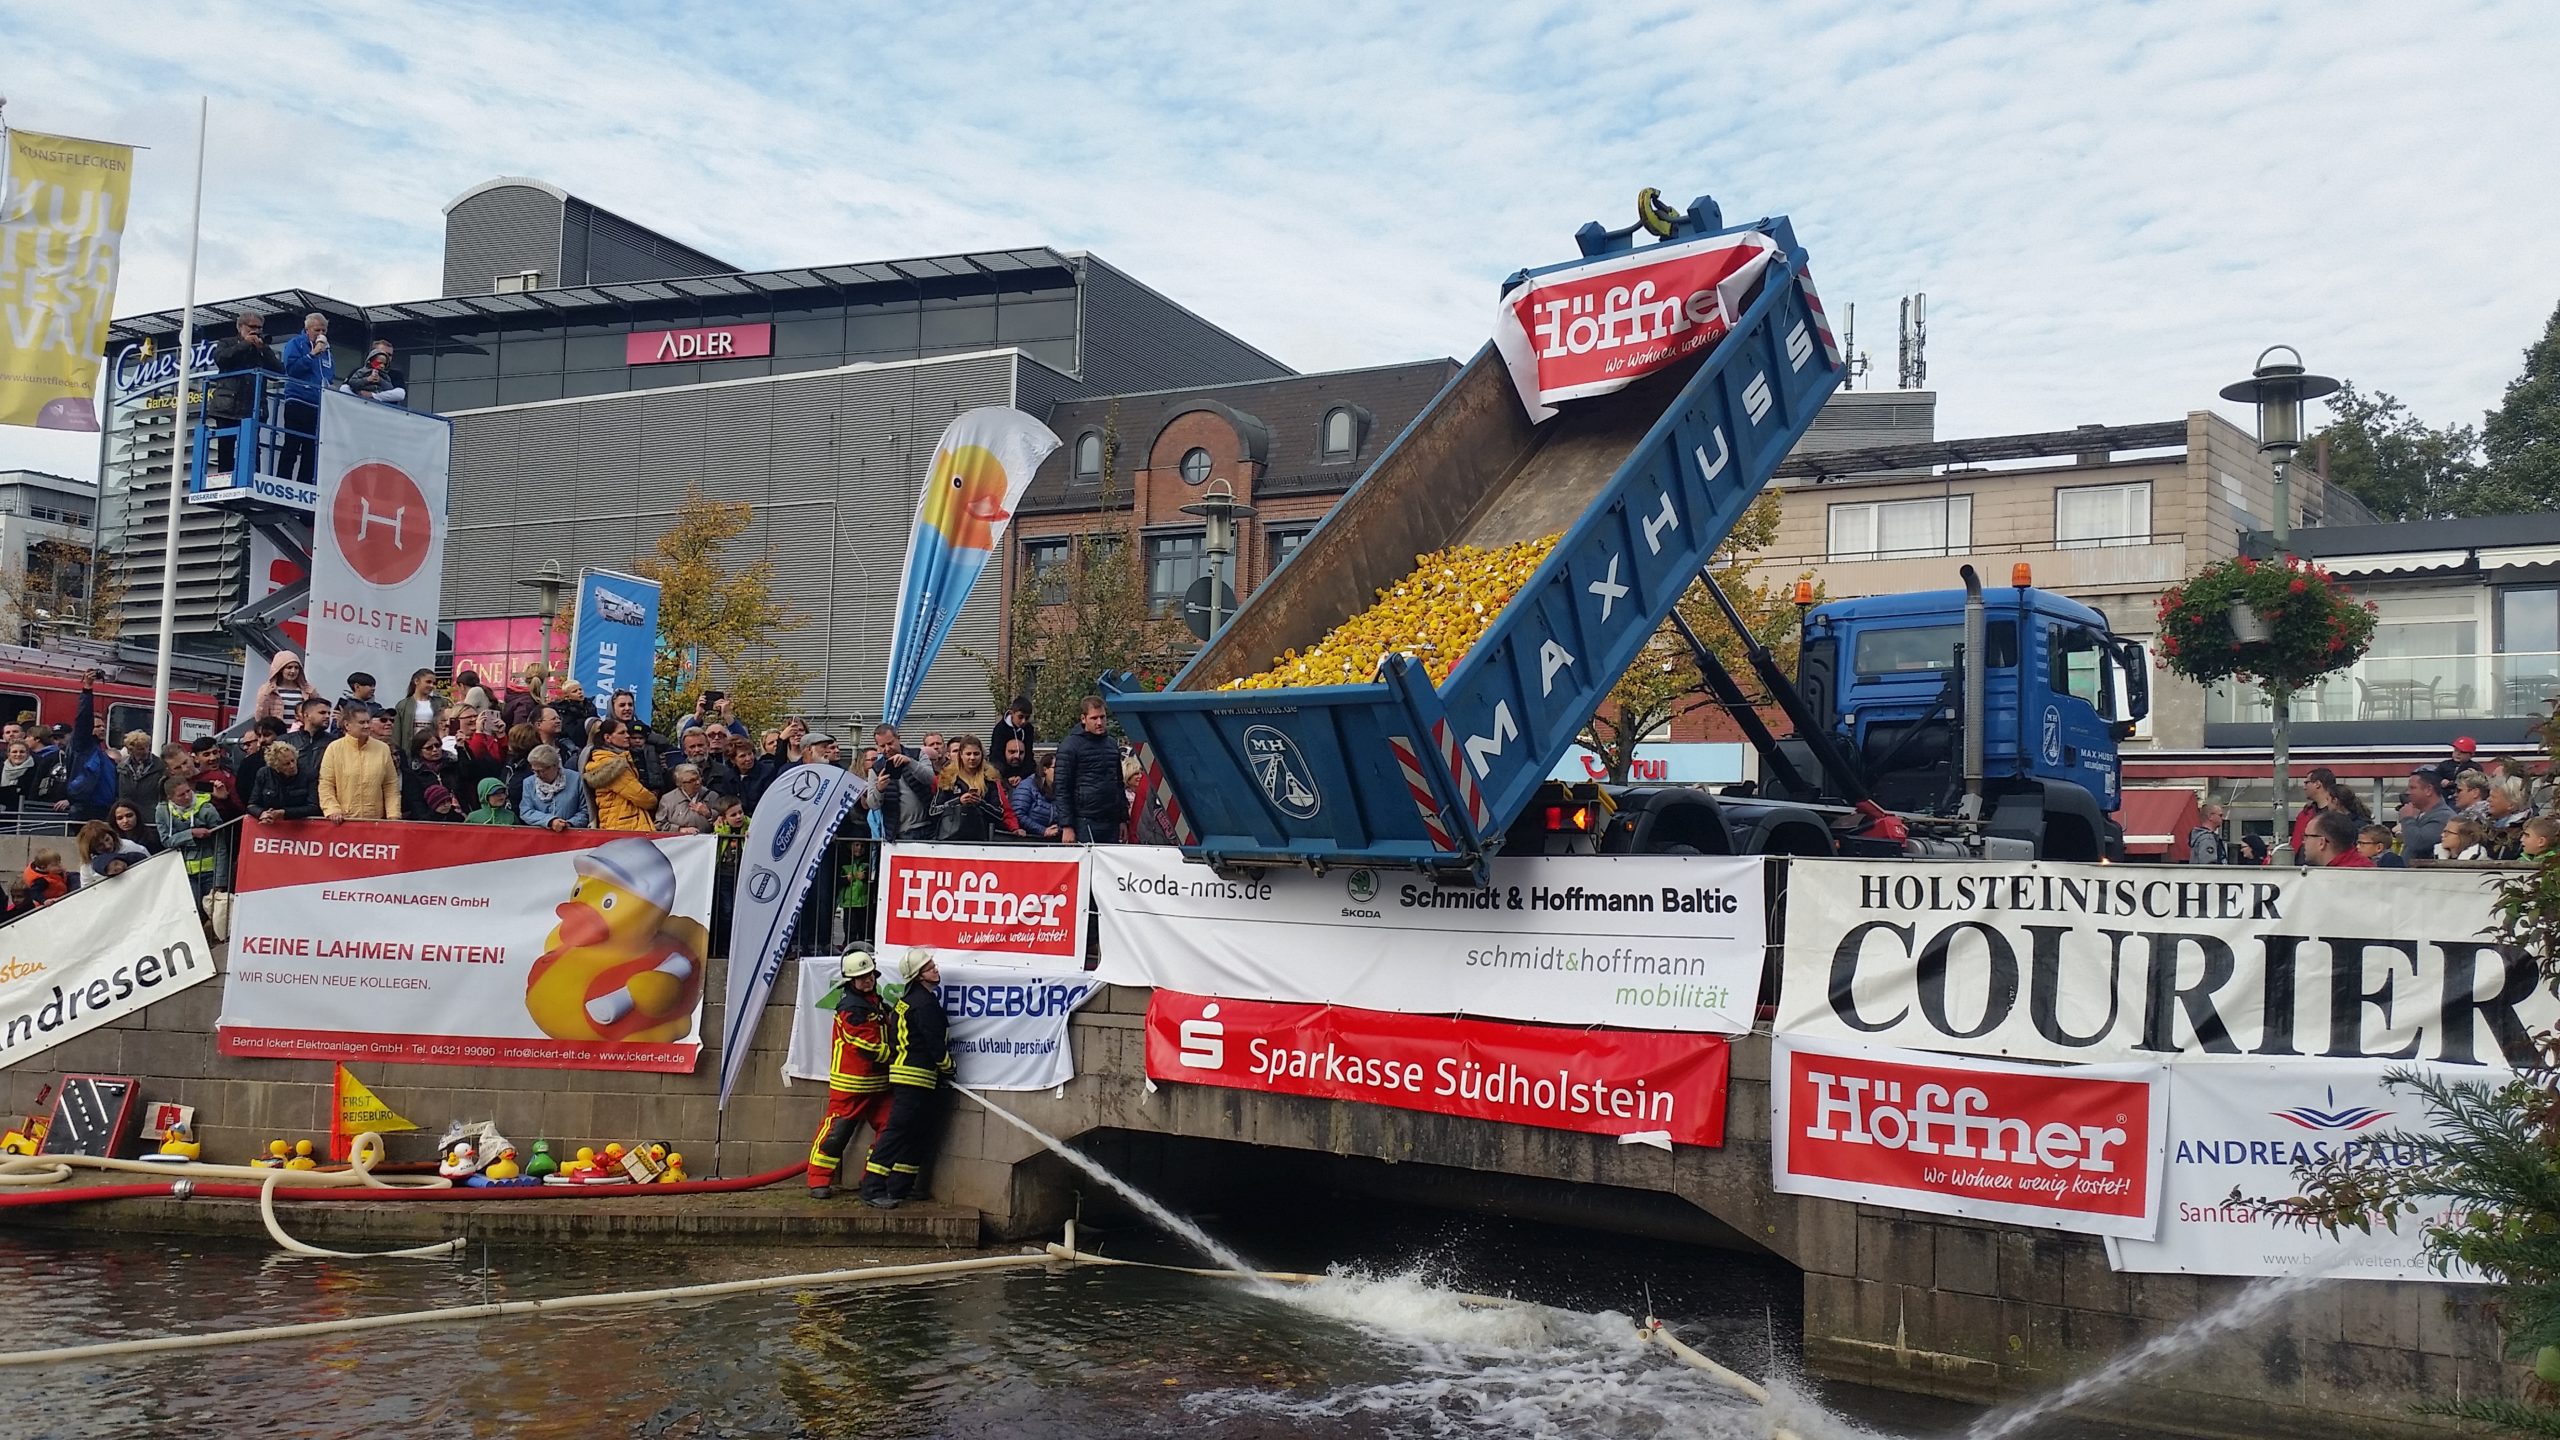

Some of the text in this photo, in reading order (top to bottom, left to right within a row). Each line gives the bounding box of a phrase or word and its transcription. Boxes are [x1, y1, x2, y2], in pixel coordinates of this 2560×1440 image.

[19, 144, 126, 172] KUNSTFLECKEN
[1534, 280, 1722, 360] Höffne
[656, 330, 733, 360] ADLER
[1605, 357, 1624, 374] Wo
[1628, 345, 1677, 368] Wohnen
[145, 397, 170, 409] Ganz
[255, 479, 318, 504] VOSS-KR
[1465, 320, 1815, 780] MAX HUSS
[323, 600, 428, 637] HOLSTEN
[346, 633, 404, 655] GALERIE
[1250, 738, 1287, 752] MH
[2080, 748, 2097, 759] MAX
[1632, 759, 1668, 780] TUI
[813, 778, 831, 806] mazda
[253, 837, 400, 861] BERND ICKERT
[775, 821, 797, 852] Ford
[322, 889, 490, 908] ELEKTROANLAGEN GmbH
[756, 873, 771, 898] VOLVO
[896, 868, 1067, 927] Höffner
[1117, 872, 1272, 901] skoda-nms.de
[1400, 884, 1738, 914] Schmidt & Hoffmann Baltic
[1860, 873, 2283, 920] HOLSTEINISCHER
[1341, 907, 1382, 919] ŠKODA
[242, 936, 506, 965] KEINE LAHMEN ENTEN!
[762, 886, 810, 989] Autohaus
[958, 928, 1068, 948] Wo Wohnen wenig kostet!
[0, 956, 47, 984] sten
[239, 971, 431, 991] WIR SUCHEN NEUE KOLLEGEN.
[0, 941, 195, 1050] ndresen
[1615, 982, 1730, 1010] mobilität
[1828, 920, 2554, 1069] COURIER
[232, 1036, 685, 1064] Bernd Ickert Elektroanlagen GmbH Tel. 04321 99090 info@ickert-elt.de www.ickert-elt.de
[979, 1037, 1012, 1054] Urlaub
[1249, 1038, 1424, 1094] Sparkasse
[1435, 1057, 1674, 1123] Südholstein
[341, 1095, 373, 1108] FIRST
[341, 1108, 395, 1123] REISEBÜRO
[1806, 1071, 2127, 1173] Höffner
[2175, 1140, 2329, 1167] ANDREAS
[1923, 1166, 2131, 1201] Wo Wohnen wenig kostet!
